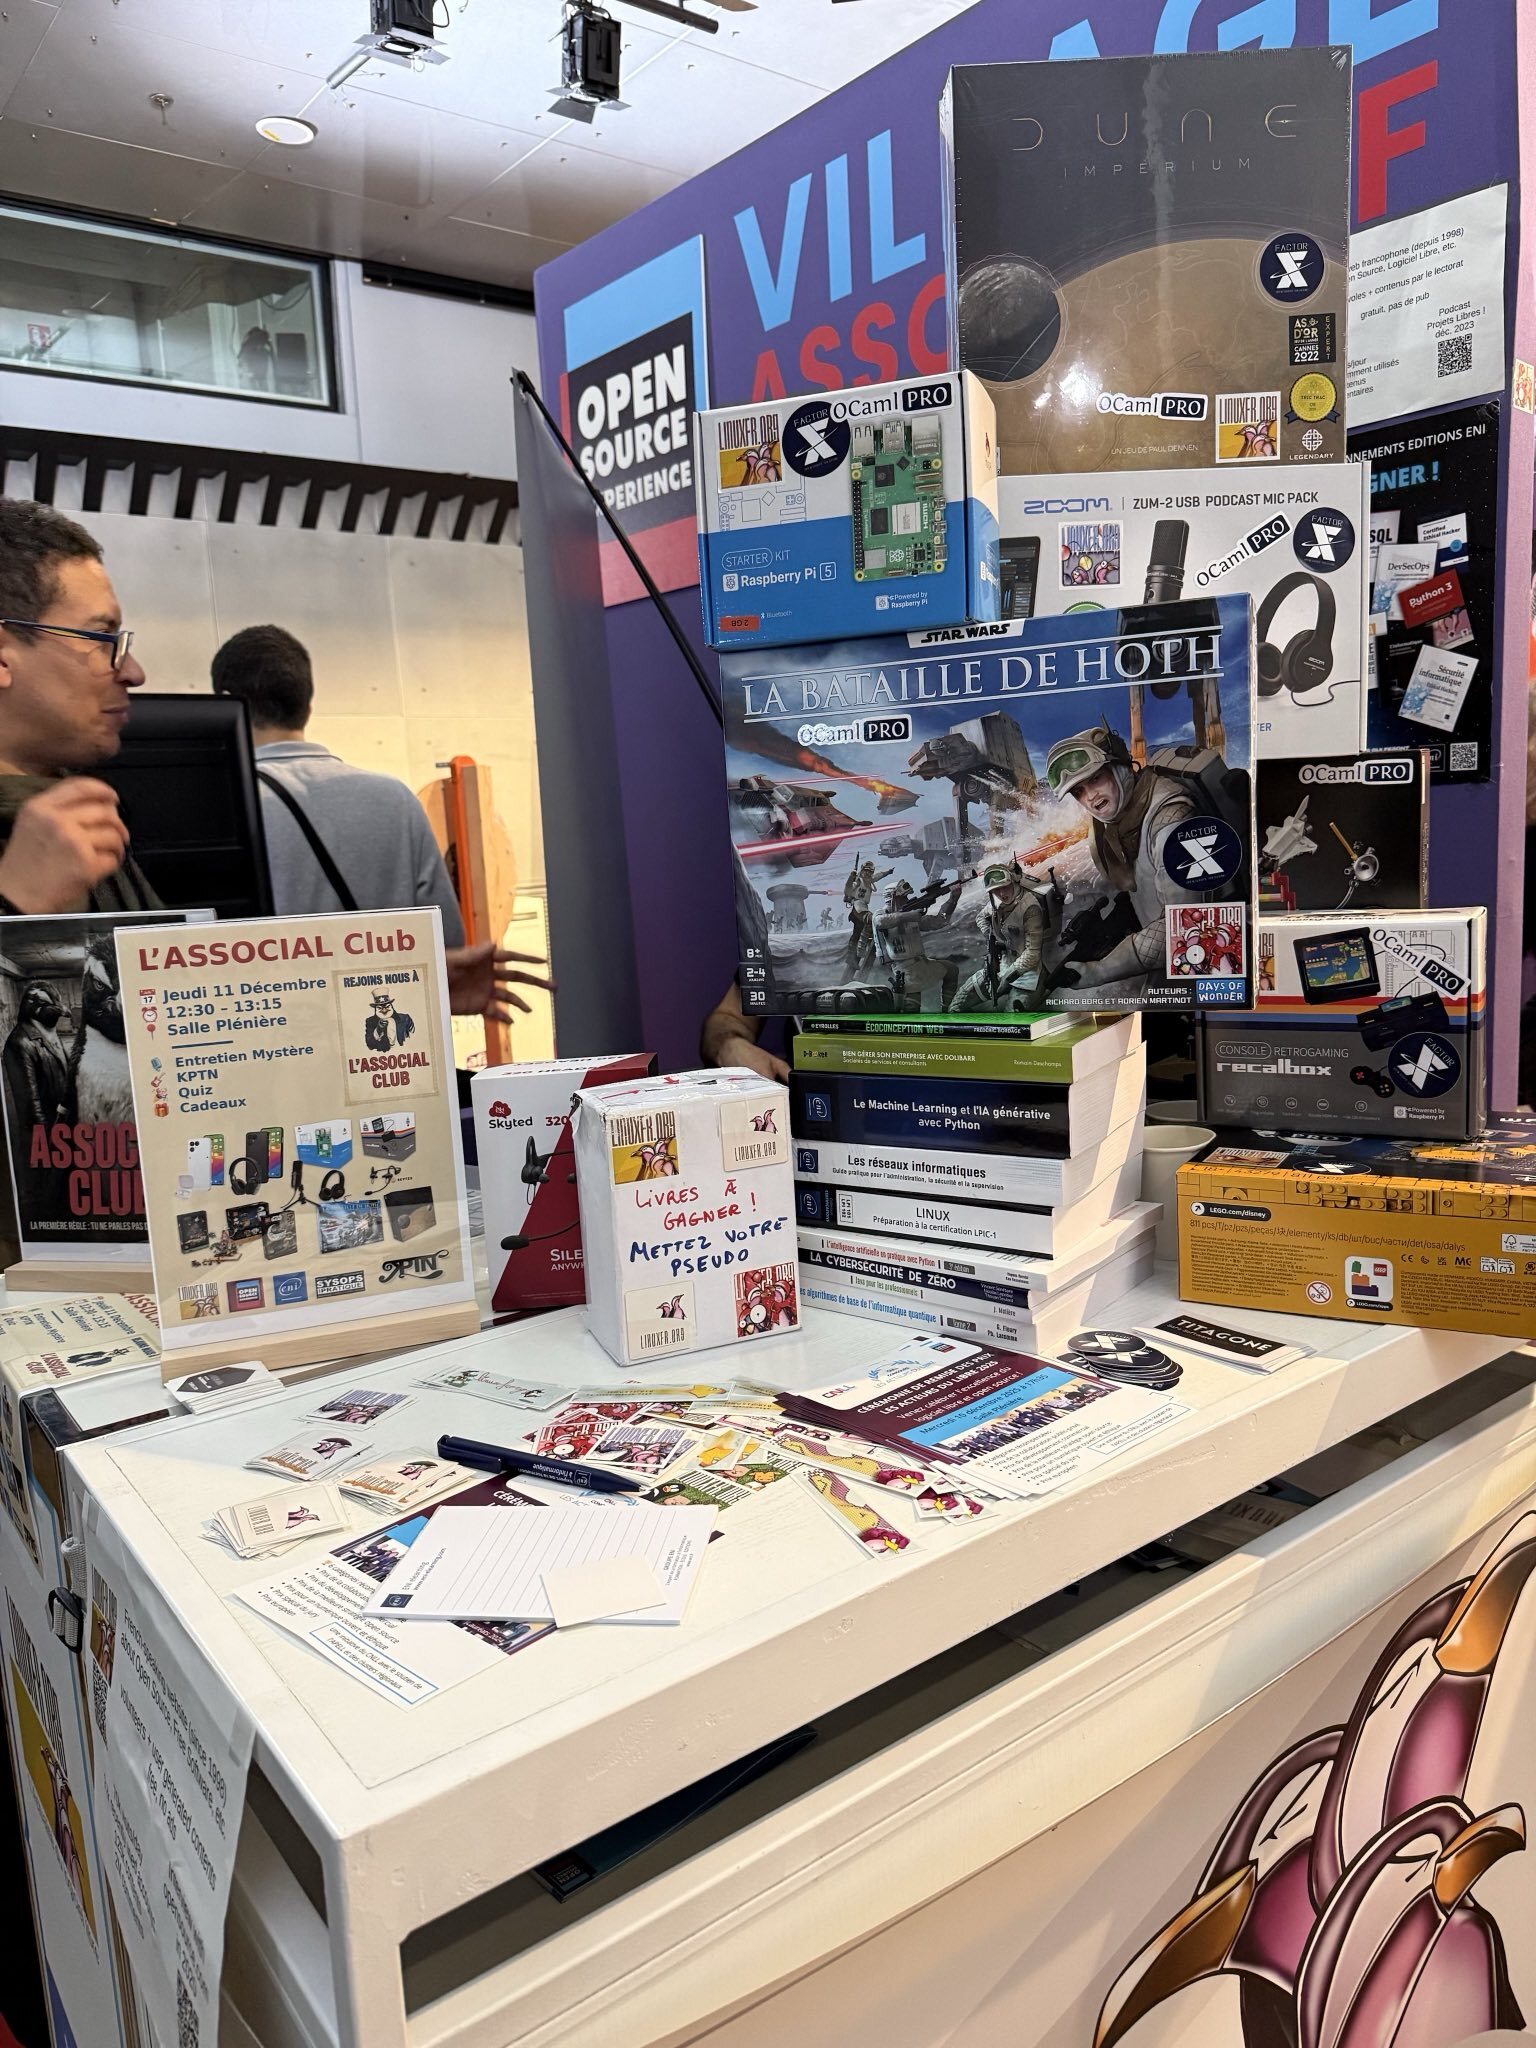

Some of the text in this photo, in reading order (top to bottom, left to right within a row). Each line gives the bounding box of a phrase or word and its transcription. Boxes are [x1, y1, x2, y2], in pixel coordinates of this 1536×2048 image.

[1012, 104, 1297, 151] DUNE
[1064, 157, 1250, 177] IMPERIUM
[1275, 242, 1308, 252] FACTOR
[1361, 227, 1464, 270] francophone (depuis 1998)
[1388, 254, 1418, 270] Logiciel
[1375, 259, 1464, 295] contenus par lectorat
[1388, 291, 1430, 313] pas pub
[1438, 300, 1471, 316] Podcast
[1426, 308, 1481, 331] Projets Libres
[1454, 320, 1475, 334] 2023
[1324, 316, 1332, 360] EXPERT
[1294, 351, 1319, 362] 2022
[1374, 358, 1400, 372] utilisés
[577, 344, 686, 440] OPEN
[833, 387, 948, 421] OCaml PRO
[1099, 396, 1201, 416] OCaml PRO
[793, 408, 828, 427] FACTOR
[580, 407, 688, 482] SOURCE
[1408, 428, 1463, 451] EDITIONS
[1466, 423, 1486, 438] ENI
[596, 459, 692, 516] PERIENCE
[1024, 491, 1319, 514] ZOOM ZUM-2 USB PODCAST MIC PACK
[1311, 515, 1344, 528] FACTOR
[1423, 525, 1446, 535] Certified
[726, 550, 791, 567] STARTER KIT
[1196, 520, 1285, 586] OCaml PRO
[1388, 562, 1430, 572] DevSecOps
[741, 571, 801, 588] Raspberry
[1409, 587, 1445, 608] Python
[766, 610, 792, 619] Bluetooth
[921, 623, 1010, 644] STAR WARS
[743, 634, 1224, 717] LA BATAILLE DE HOTH
[800, 721, 906, 745] OCaml PRO
[1302, 765, 1407, 781] OCaml PRO
[1177, 825, 1218, 841] FACTOR
[344, 929, 416, 956] Club
[1374, 930, 1460, 990] OCaml PRO
[162, 977, 327, 1004] Jeudi 11 Décembre
[343, 972, 410, 988] REJOINS NOUS
[166, 998, 282, 1020] 12:30 13:15
[1046, 998, 1080, 1006] RICHARD
[1118, 997, 1148, 1005] ADRIEN
[1149, 996, 1191, 1004] MARTINOT
[167, 1013, 287, 1036] Salle Plénière
[866, 1021, 923, 1034] ÉCOCONCEPTION
[175, 1044, 314, 1068] Entretien Mystère
[892, 1052, 926, 1060] ENTREPRISE
[944, 1054, 976, 1062] DOLIBARR
[1219, 1045, 1349, 1058] CONSOLE RETROGAMING
[1425, 1038, 1456, 1066] FACTOR
[177, 1069, 218, 1083] KPTN
[1217, 1059, 1332, 1076] recalbox
[372, 1071, 410, 1090] CLUB
[178, 1085, 213, 1101] Quiz
[180, 1097, 247, 1113] Cadeaux
[854, 1099, 1051, 1120] Le Machine Learning générative
[489, 1116, 570, 1130] Skyted 320
[918, 1118, 981, 1130] avec Python
[30, 1122, 138, 1168] ASSOC
[847, 1155, 986, 1179] Les réseaux informatiques
[663, 1203, 741, 1231] GAGNER
[916, 1207, 950, 1222] LINUX
[1210, 1206, 1266, 1219] LEGO.com/disney
[38, 1220, 131, 1230] PREMIÈRE PARLES
[873, 1216, 997, 1239] Préparation certification LPIC-1
[630, 1217, 788, 1262] METTEZ VOTRE
[550, 1248, 584, 1262] SILE
[671, 1249, 749, 1277] PSEUDO
[810, 1252, 956, 1289] LA CYBERSÉCURITÉ DE ZÉRO
[316, 1274, 364, 1290] SYSOPS
[807, 1288, 936, 1323] algorithmes quantique
[1003, 1325, 1017, 1334] Fleury
[1177, 1319, 1273, 1352] TITAGONE
[857, 1386, 912, 1415] CÉRÉMONIE
[924, 1369, 957, 1387] REMISE
[972, 1351, 995, 1366] PRIX
[898, 1387, 939, 1408] ACTEURS
[952, 1369, 977, 1386] LIBRE
[991, 1373, 1018, 1391] source
[920, 1416, 955, 1435] Mercredi
[378, 1628, 400, 1645] source
[120, 1632, 187, 1756] about Open Free
[124, 1608, 227, 1809] French-speaking 1998)
[120, 1684, 147, 1741] volunteers
[162, 1768, 193, 1834] generated
[191, 1827, 218, 1892] contents
